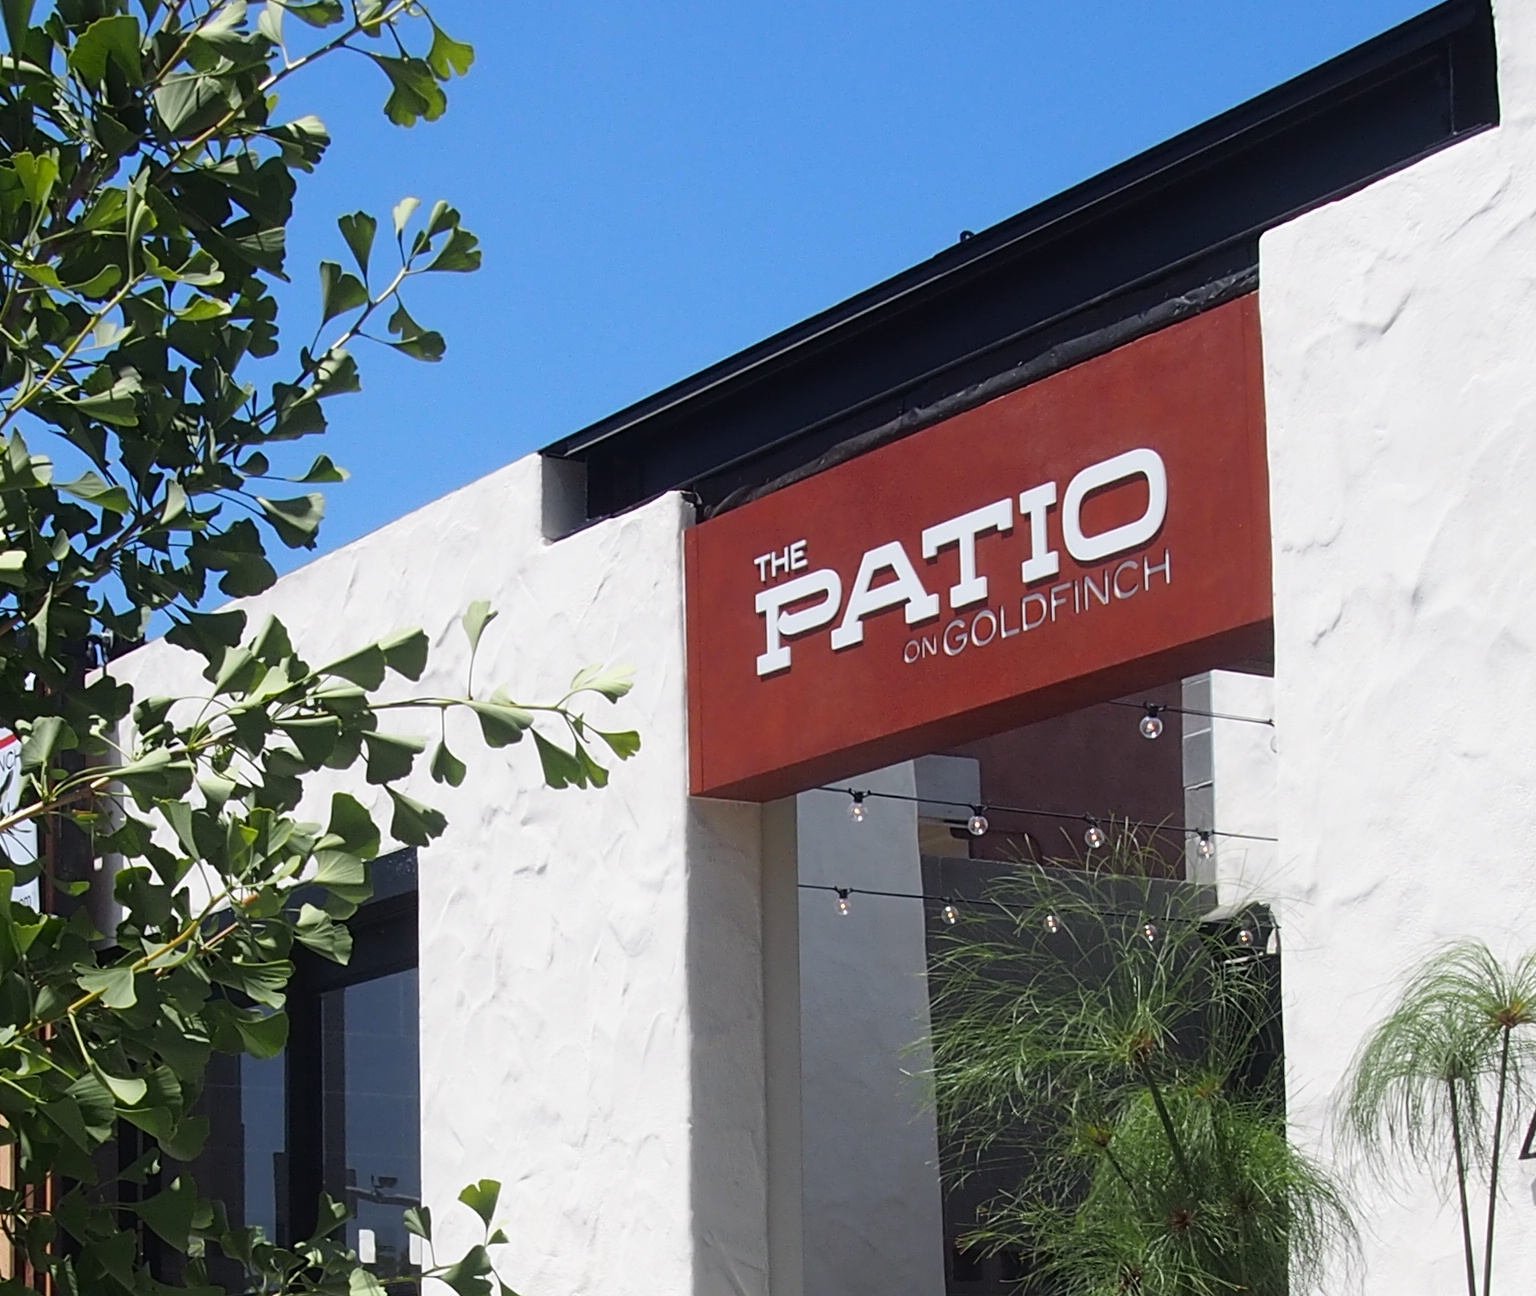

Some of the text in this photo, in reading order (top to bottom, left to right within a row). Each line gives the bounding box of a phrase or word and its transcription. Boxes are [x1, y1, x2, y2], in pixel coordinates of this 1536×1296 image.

[754, 539, 809, 581] THE
[755, 448, 1168, 677] PATIO
[903, 549, 1171, 664] ON GOLDFINCH
